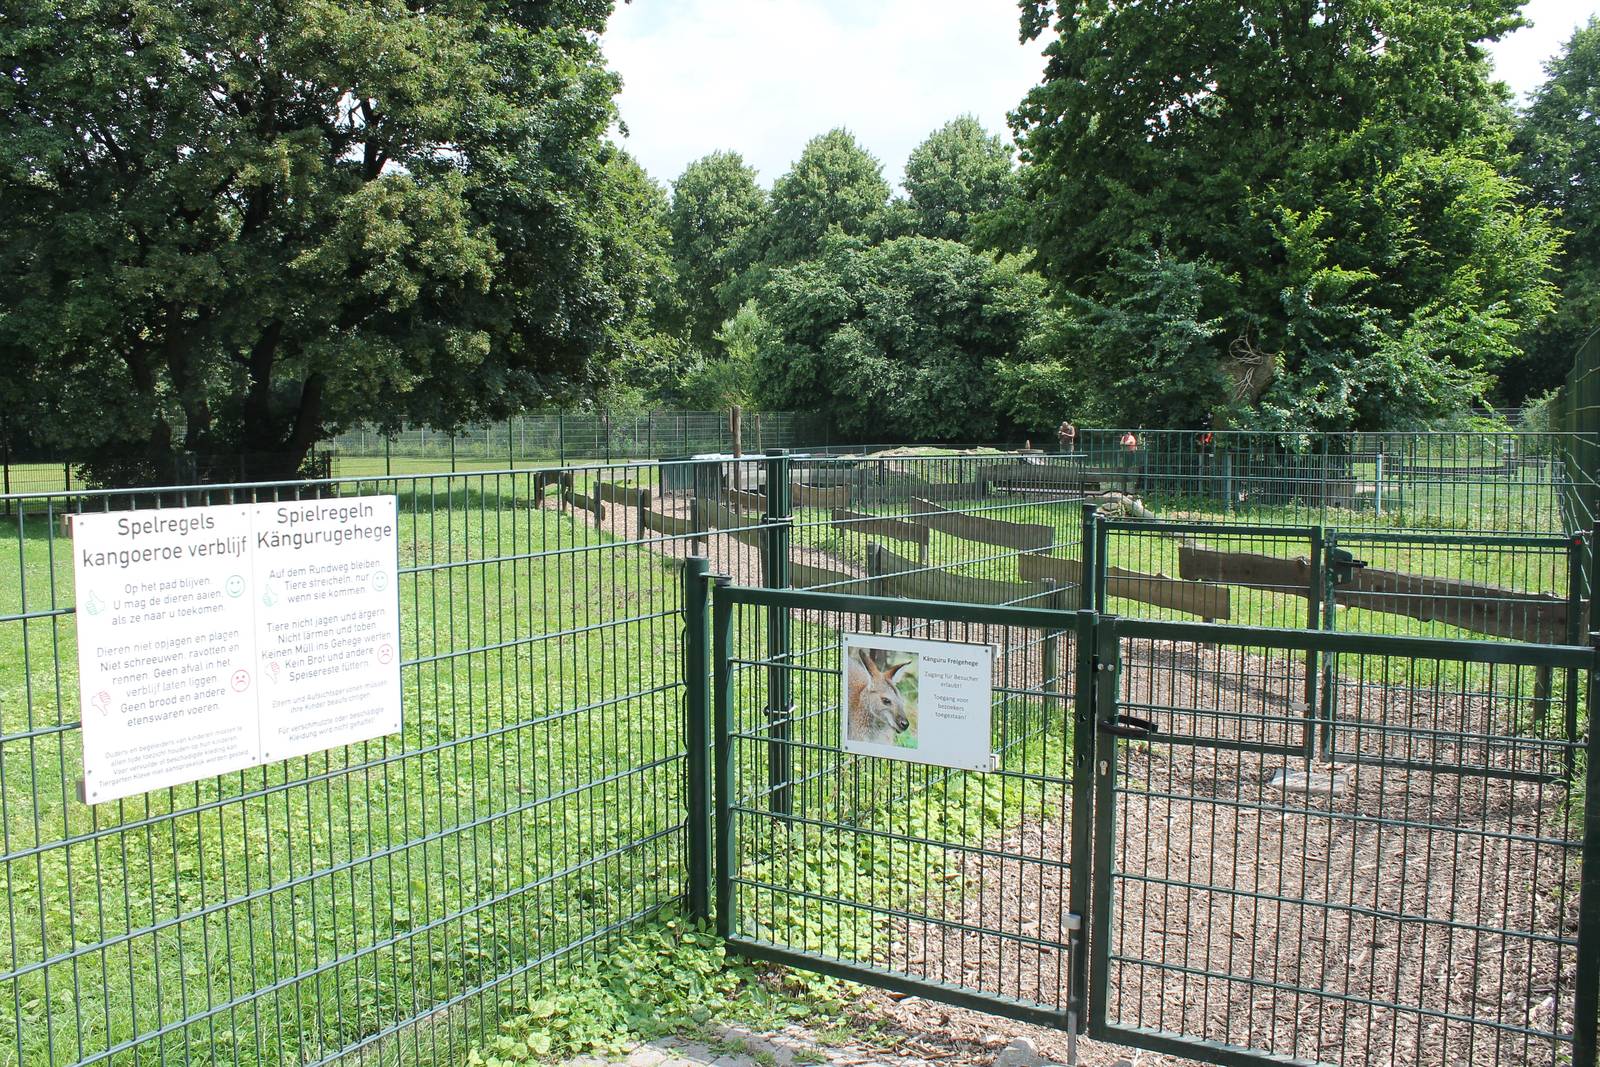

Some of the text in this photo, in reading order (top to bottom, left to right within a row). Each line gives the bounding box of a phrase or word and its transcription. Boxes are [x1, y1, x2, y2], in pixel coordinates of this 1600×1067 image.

[277, 502, 373, 527] Spielregeln
[118, 513, 214, 539] Spelregels
[258, 524, 391, 550] Kängurugehege
[83, 536, 247, 568] kangoeroe verblijf
[269, 569, 285, 578] Auf
[288, 568, 306, 577] dem
[309, 564, 348, 573] Rundweg
[125, 584, 138, 596] Op
[141, 582, 156, 591] het
[160, 580, 177, 592] pad
[285, 581, 307, 590] Tiere
[356, 574, 369, 582] nur
[114, 600, 120, 610] U
[124, 599, 146, 609] mag
[150, 596, 160, 606] de
[164, 593, 193, 604] dieren
[288, 593, 311, 603] wenn
[112, 616, 126, 625] als
[130, 614, 141, 623] ze
[144, 611, 166, 621] naar
[267, 622, 289, 632] Tiere
[292, 618, 312, 628] nicht
[316, 616, 338, 627] jagen
[341, 612, 356, 621] und
[278, 633, 300, 644] Nicht
[337, 625, 351, 634] und
[97, 645, 130, 657] Dieren
[134, 642, 152, 651] niet
[155, 637, 191, 649] opjagen
[262, 649, 292, 659] Keinen
[296, 643, 313, 654] Müll
[316, 641, 328, 649] ins
[331, 637, 361, 648] Gehege
[100, 662, 121, 671] Niet
[189, 646, 226, 657] ravotten
[286, 647, 374, 669] Kein Brot und andere
[948, 658, 978, 667] Freigehege
[154, 666, 178, 678] Geen
[181, 664, 202, 674] afval
[206, 661, 213, 669] in
[217, 659, 230, 667] het
[289, 665, 339, 683] Speisereste
[126, 682, 160, 697] verblijf
[163, 679, 185, 691] laten
[121, 688, 226, 713] Geen brood en andere
[127, 708, 184, 727] etenswaren
